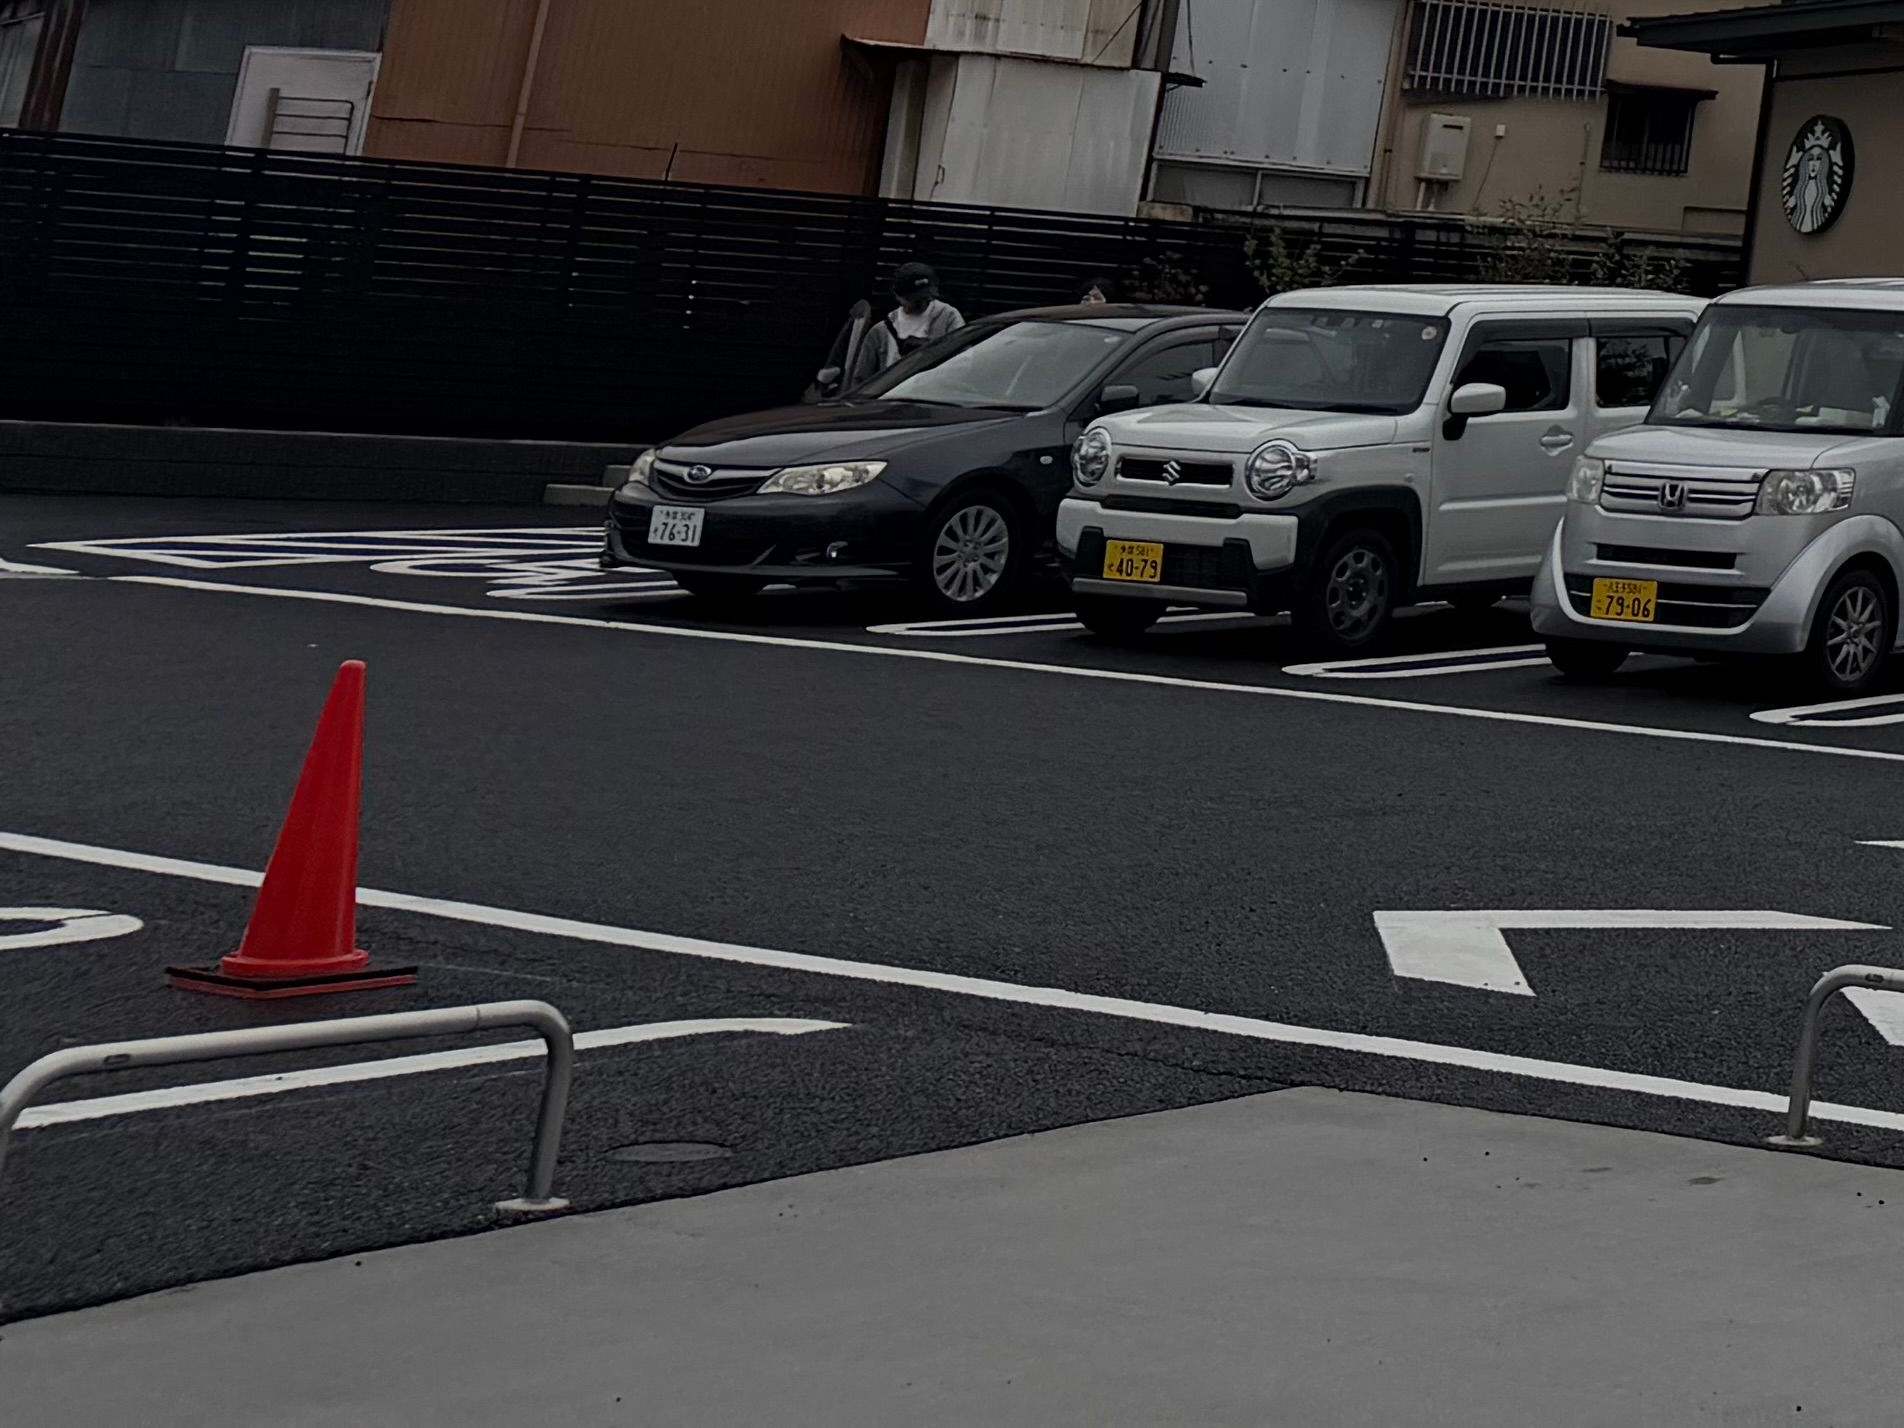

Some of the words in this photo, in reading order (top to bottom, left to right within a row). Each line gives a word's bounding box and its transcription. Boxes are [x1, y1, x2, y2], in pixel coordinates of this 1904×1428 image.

[660, 521, 697, 543] 76-31
[1116, 558, 1158, 579] 40-79
[1605, 595, 1652, 618] 79-06
